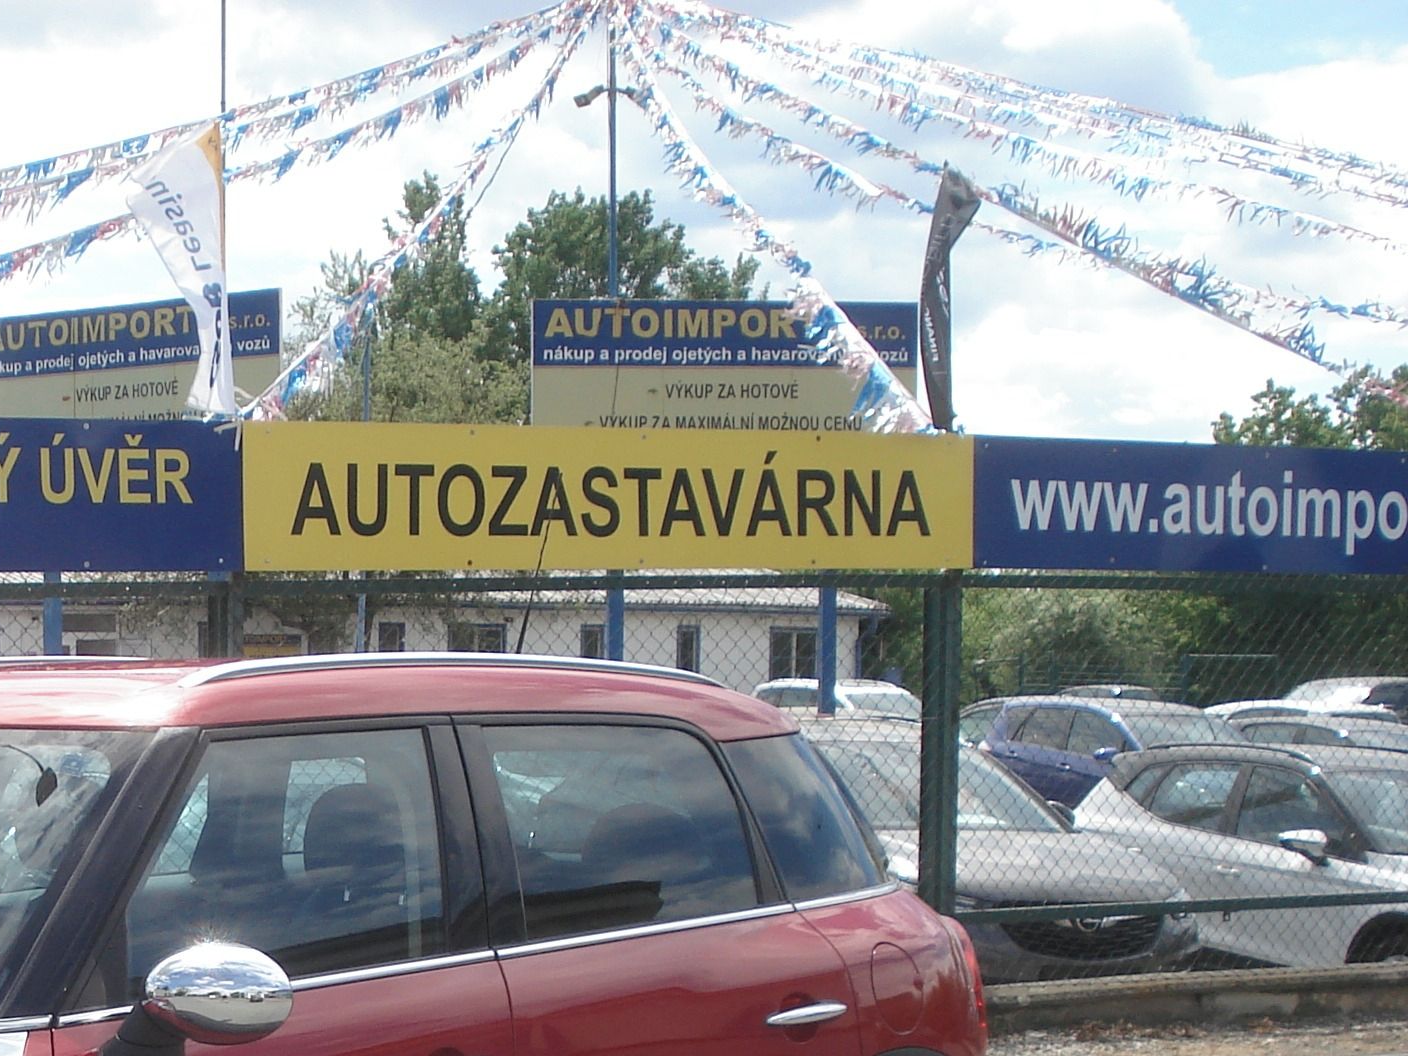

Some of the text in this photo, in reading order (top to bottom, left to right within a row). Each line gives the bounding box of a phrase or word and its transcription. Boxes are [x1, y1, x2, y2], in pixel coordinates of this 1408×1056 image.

[544, 308, 797, 339] AUTOIMPOR
[25, 360, 33, 372] a
[35, 353, 75, 374] prodej
[78, 348, 125, 370] ojetých
[128, 351, 137, 363] a
[236, 335, 272, 352] vozů
[543, 345, 596, 364] nákup
[599, 350, 610, 361] a
[614, 346, 668, 365] prodej
[672, 346, 732, 365] ojetých
[737, 350, 747, 361] a
[882, 347, 909, 362] ozů
[76, 377, 179, 403] VÝKUP ZA HOTOVÉ
[665, 379, 799, 400] VÝKUP ZA HOTOVÉ
[599, 413, 648, 429] VÝKUP
[653, 415, 672, 429] ZA
[675, 412, 755, 431] MAXIMÁLNÍ
[758, 412, 820, 431] MOŽNOU
[40, 433, 194, 506] ÚVĚR
[290, 451, 932, 538] AUTOZASTAVÁRNA
[1010, 470, 1408, 556] www.autoimpo
